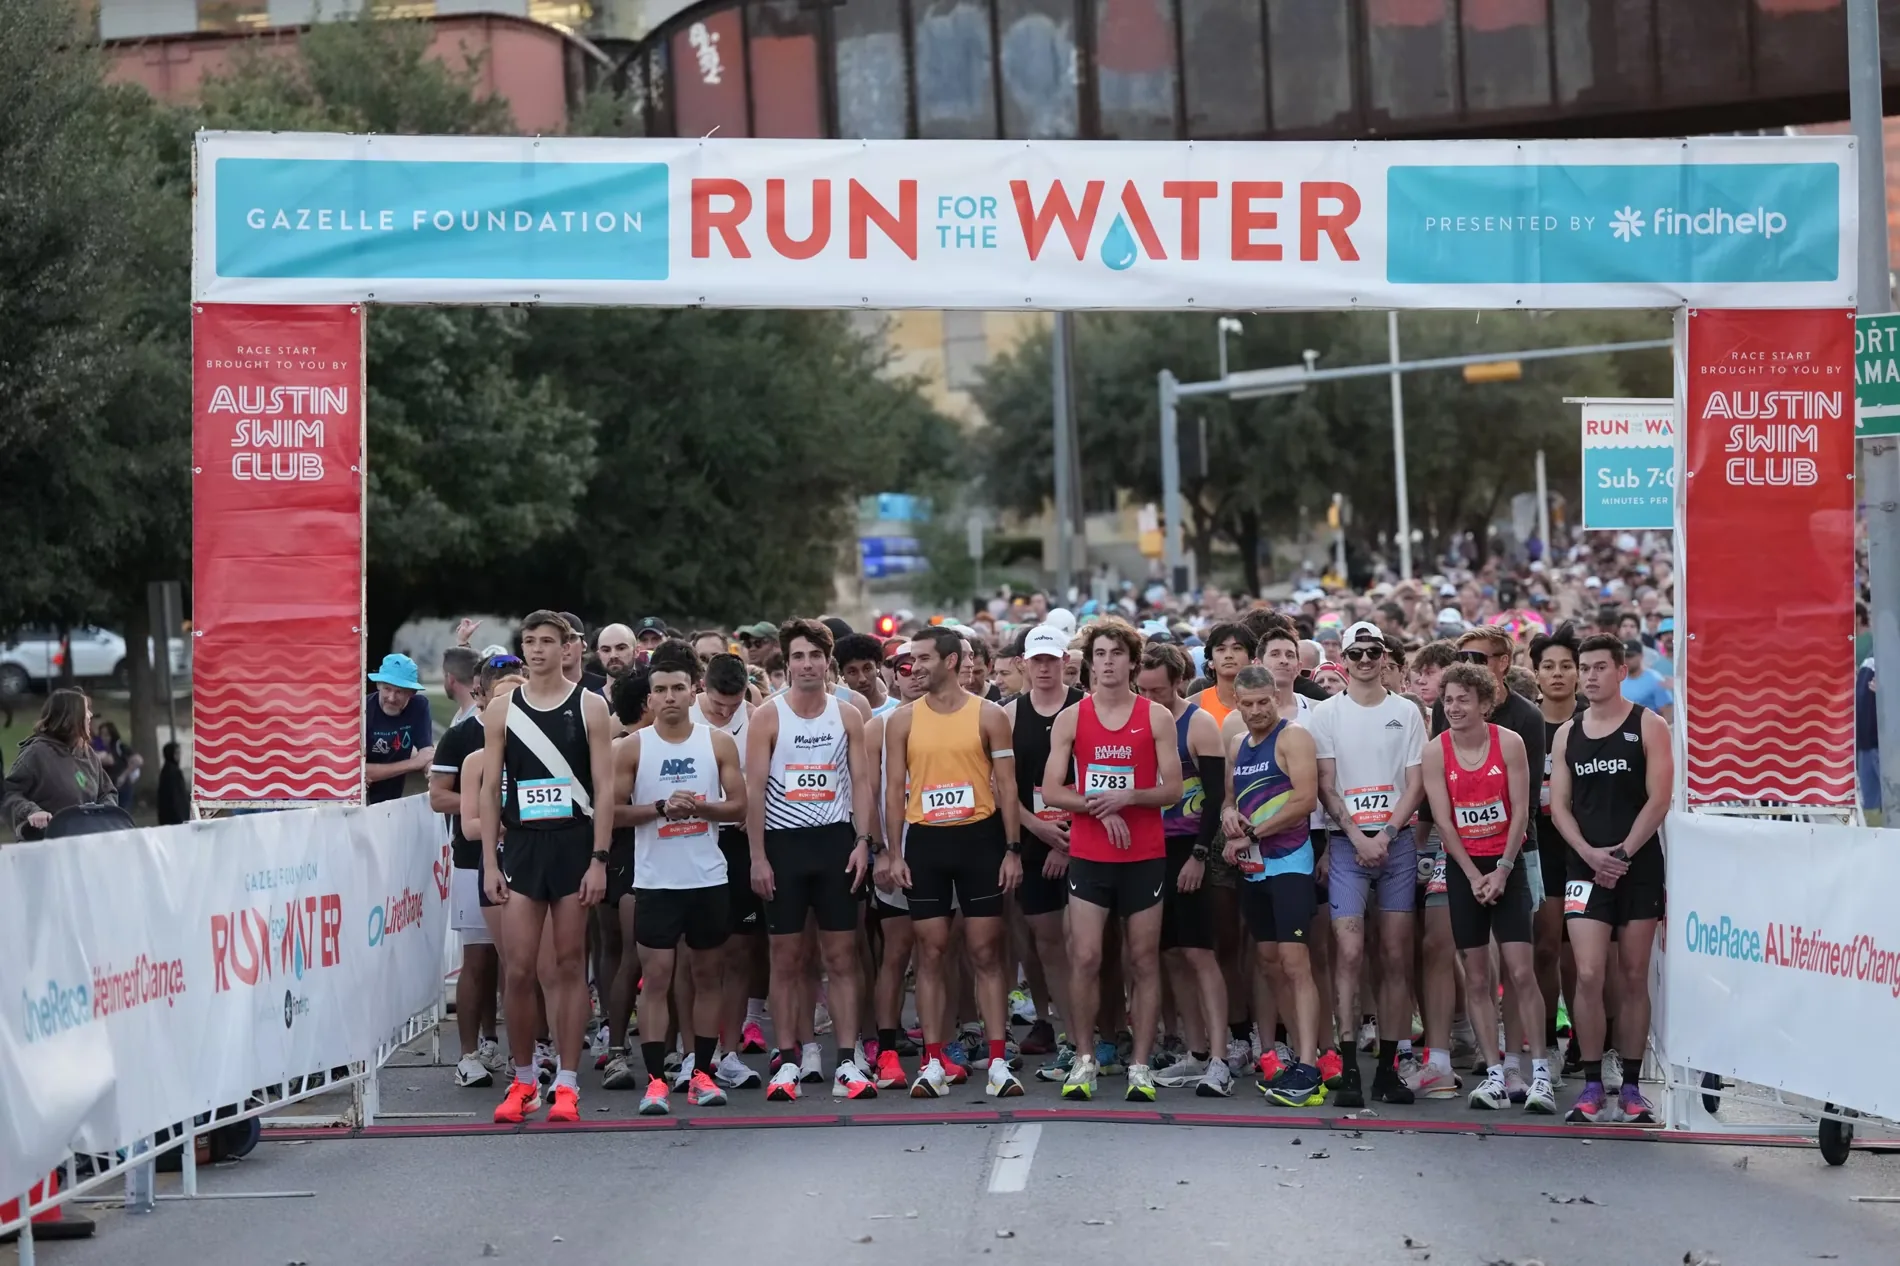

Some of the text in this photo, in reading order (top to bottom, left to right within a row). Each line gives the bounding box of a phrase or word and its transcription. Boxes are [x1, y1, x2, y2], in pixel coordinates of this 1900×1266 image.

[936, 196, 998, 220] FOR
[246, 207, 643, 233] GAZELLE FOUNDATION
[691, 177, 918, 262] RUN
[1008, 178, 1362, 270] WATER
[1425, 215, 1596, 232] PRESENTED BY
[1653, 206, 1787, 239] findhelp
[936, 225, 998, 249] THE
[237, 345, 317, 355] RACE START
[1731, 351, 1812, 360] RACE START
[206, 360, 348, 370] BROUGHT TO YOU BY
[1701, 365, 1842, 375] BROUGHT TO YOU BY
[208, 385, 348, 415] AUSTIN
[1702, 391, 1842, 420] AUSTIN
[231, 419, 325, 448] SWIM
[1586, 419, 1629, 435] RUN
[1725, 424, 1818, 453] SWIM
[232, 452, 325, 481] CLUB
[1726, 457, 1819, 486] CLUB
[1597, 467, 1640, 489] Sub
[1601, 496, 1668, 505] MINUTES PER
[1094, 745, 1132, 753] DALLAS
[1094, 752, 1132, 760] BAPTIST
[660, 757, 696, 776] ARC
[797, 773, 827, 787] 650
[1091, 774, 1127, 789] 5783
[526, 788, 562, 804] 5512
[929, 790, 965, 807] 1207
[1353, 795, 1389, 810] 1472
[1461, 806, 1499, 824] 1045
